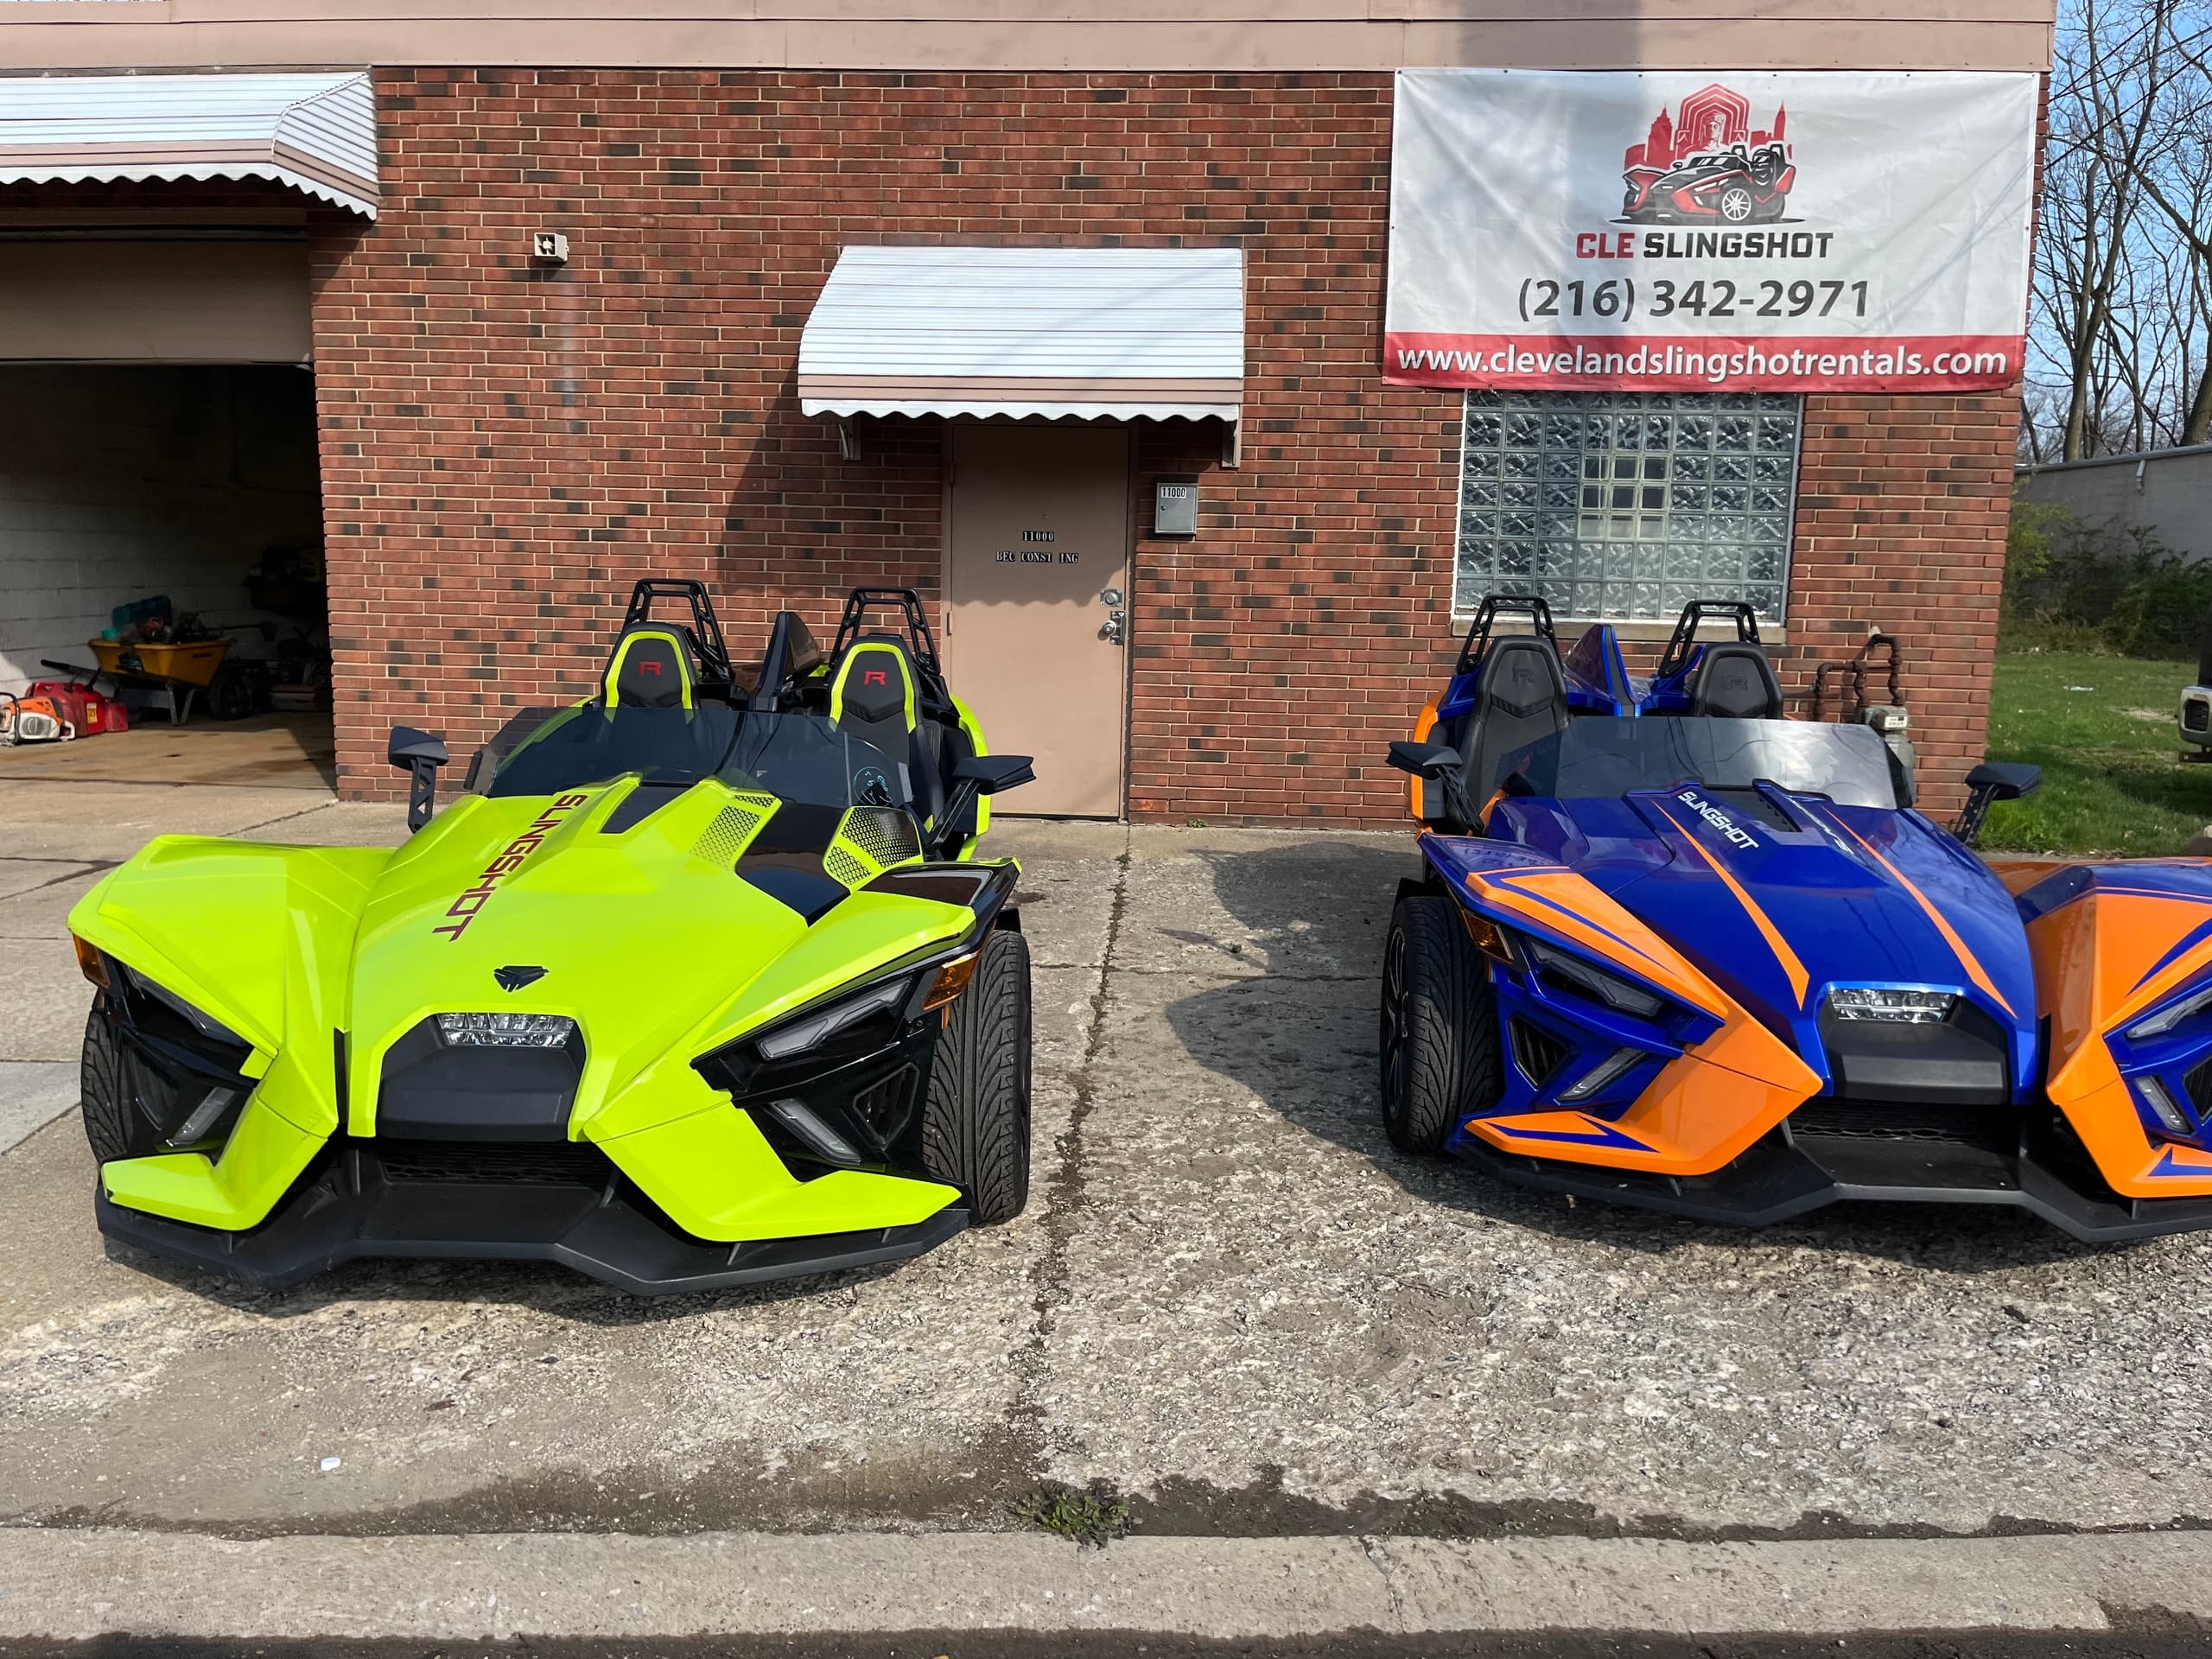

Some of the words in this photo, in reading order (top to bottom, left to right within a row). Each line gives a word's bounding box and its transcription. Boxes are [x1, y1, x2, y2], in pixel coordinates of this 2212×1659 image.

[1576, 232, 1635, 258] CLE
[1643, 232, 1834, 258] SLINGSHOT
[1519, 278, 1635, 322] (216)
[1649, 279, 1869, 317] 342-2971
[1397, 344, 2007, 383] www.clevelandslingshotrentals.com
[1162, 487, 1185, 498] 11000
[1023, 531, 1054, 542] 11000
[1677, 791, 1759, 849] SLINGSHOT
[432, 794, 588, 943] SLINGSHOT
